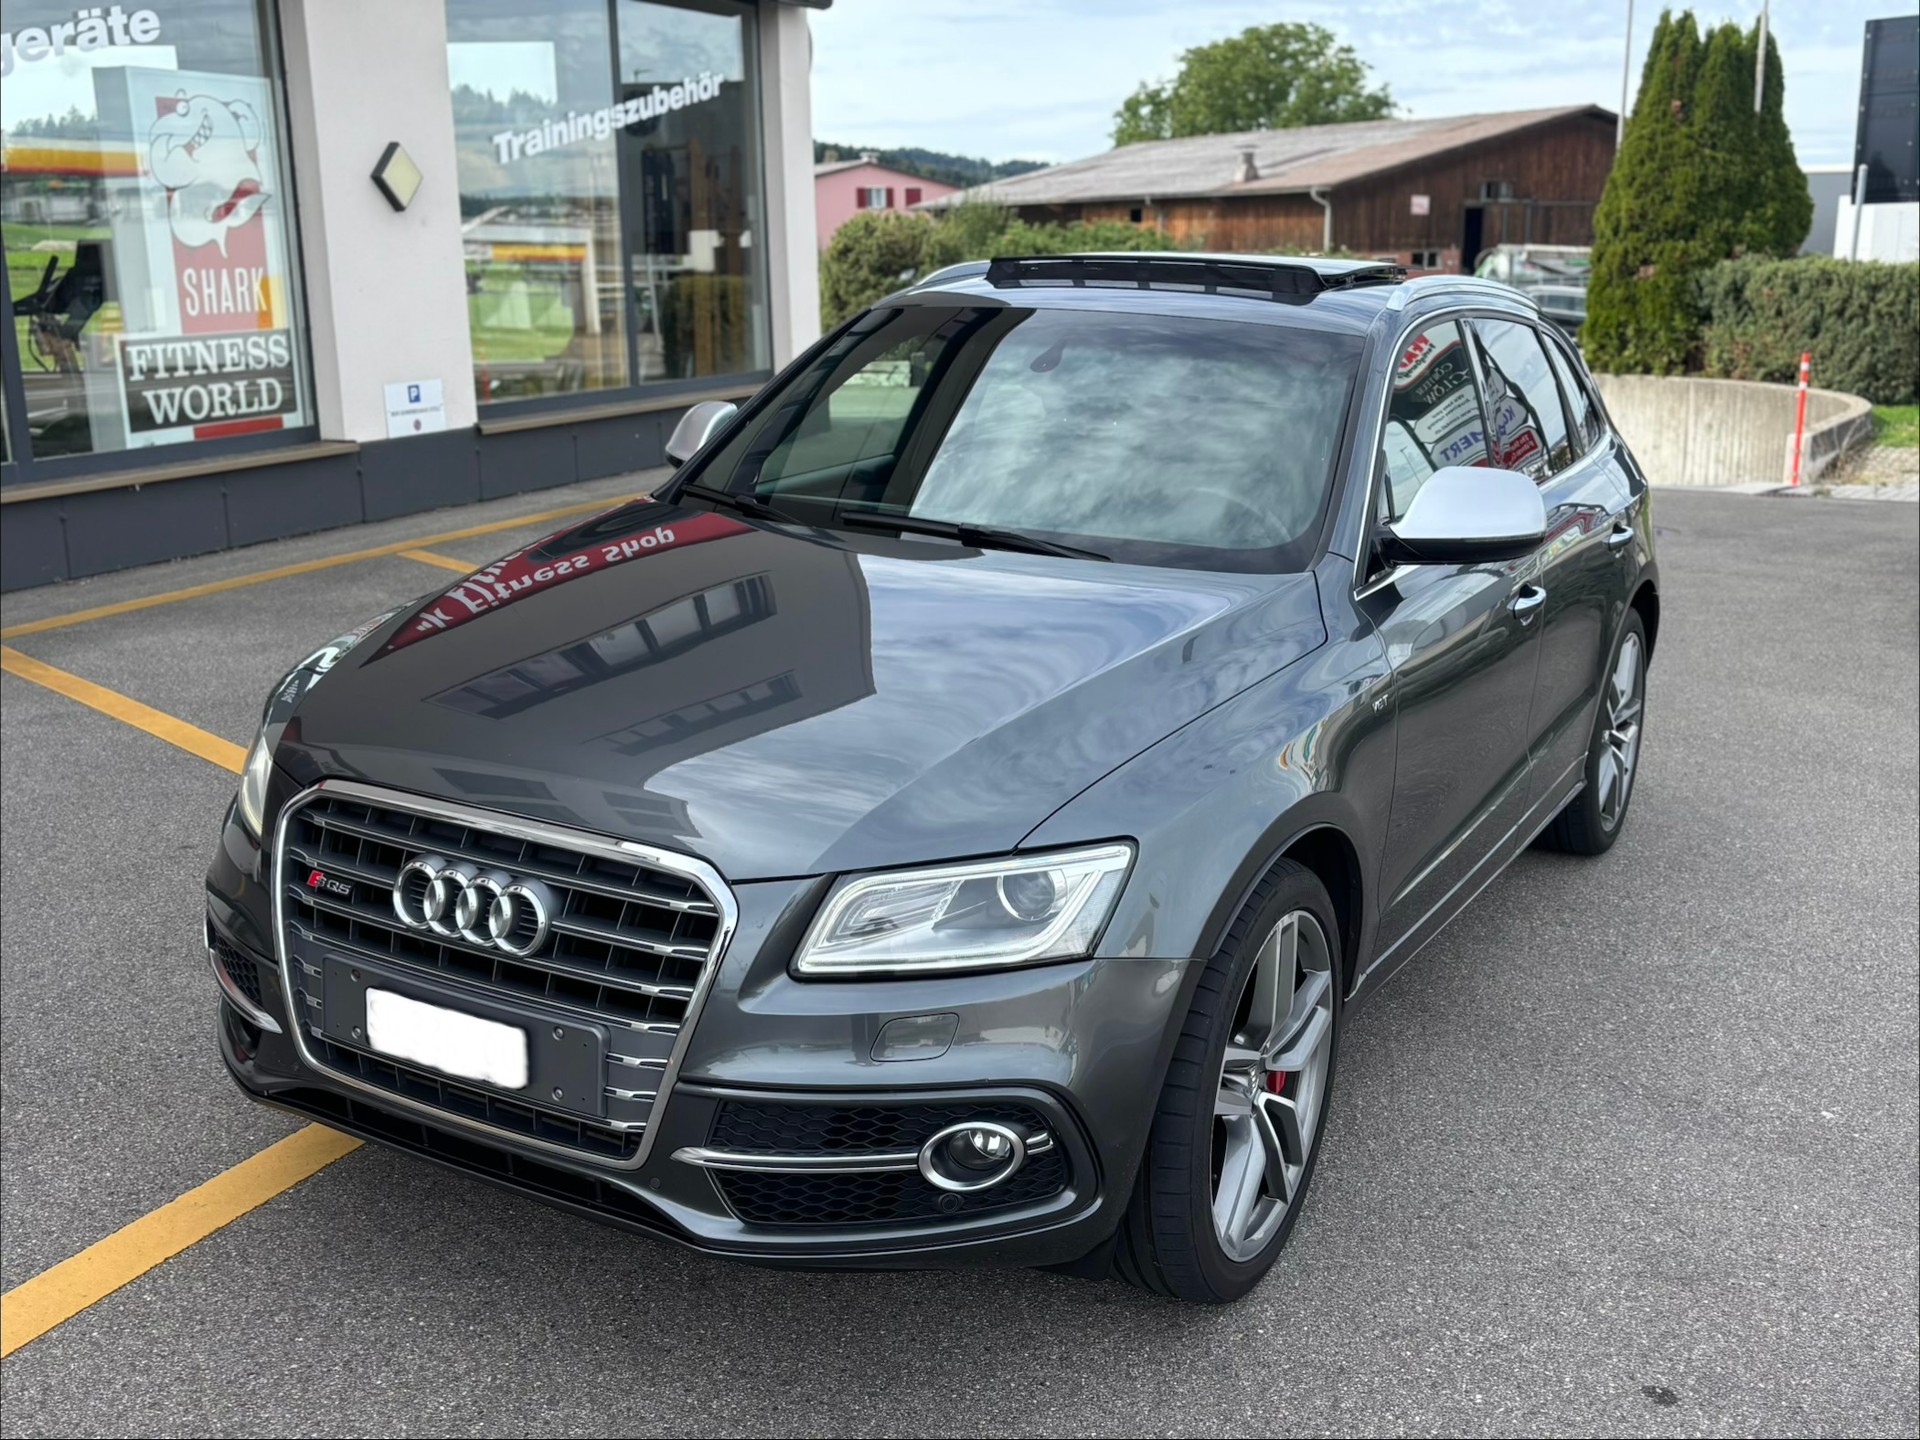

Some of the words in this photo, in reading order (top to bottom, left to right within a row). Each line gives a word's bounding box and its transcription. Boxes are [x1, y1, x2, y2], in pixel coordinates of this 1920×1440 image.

[492, 71, 724, 164] Trainingszubehör
[183, 267, 267, 316] SHARK
[126, 335, 290, 381] FITNESS
[142, 378, 283, 424] WORLD
